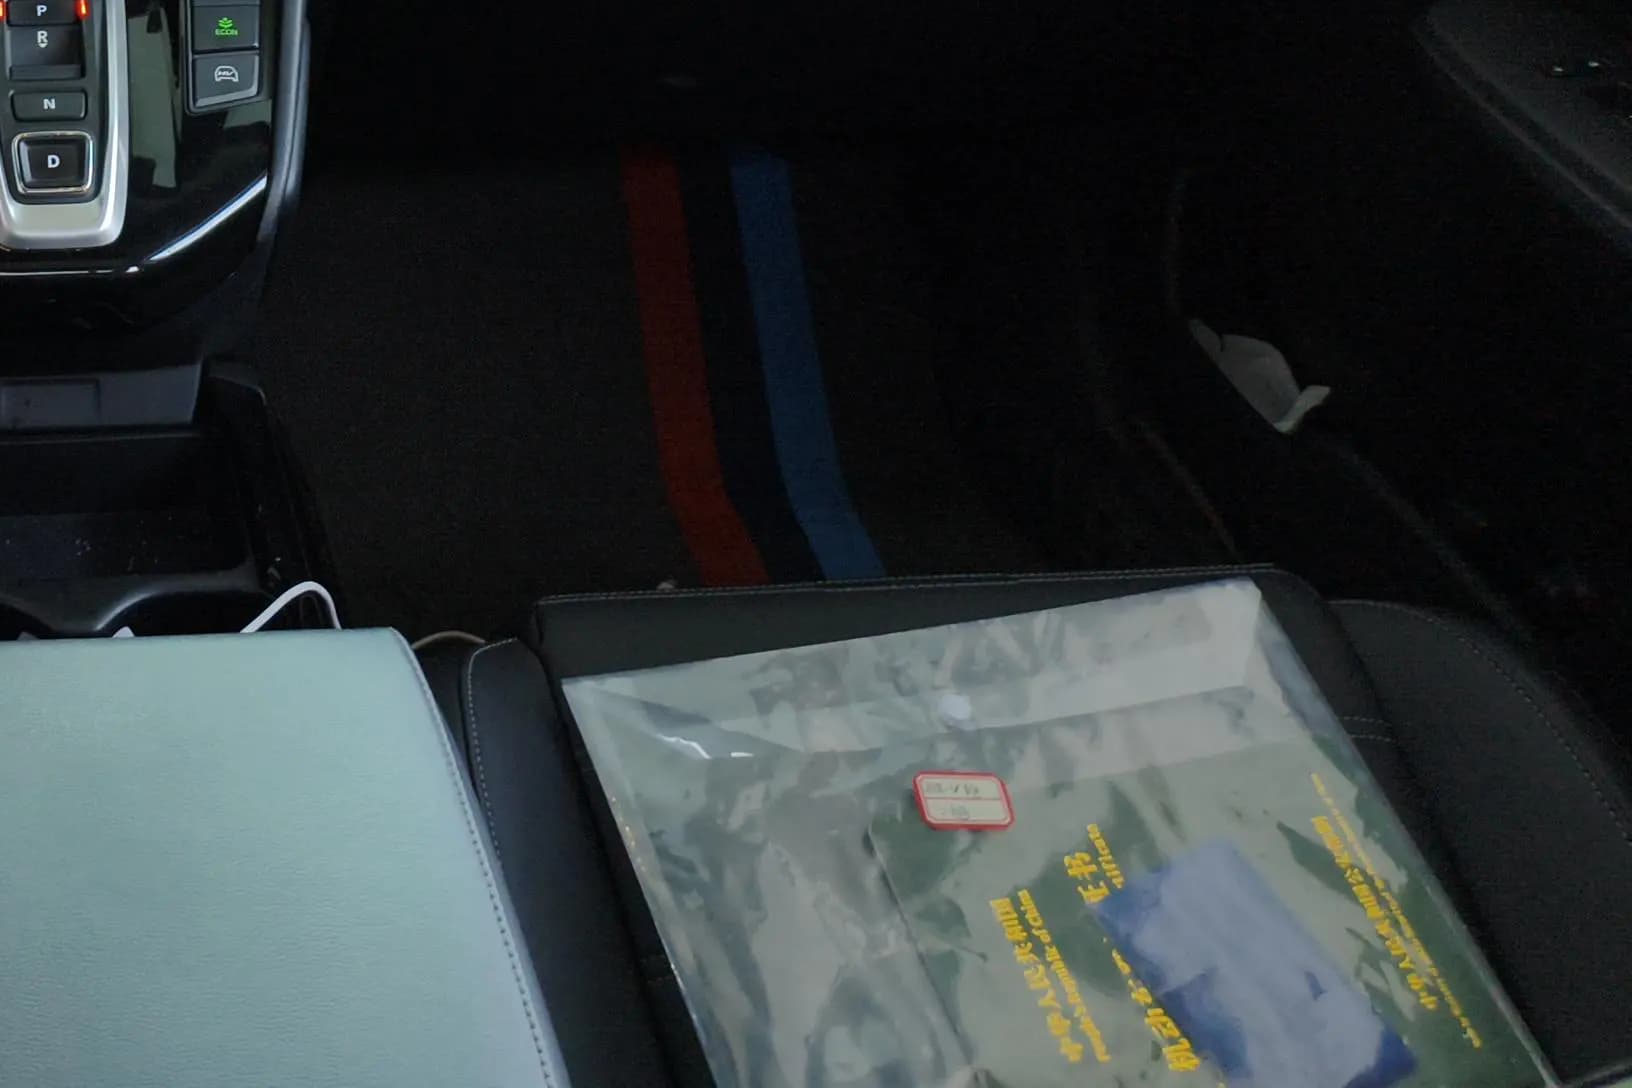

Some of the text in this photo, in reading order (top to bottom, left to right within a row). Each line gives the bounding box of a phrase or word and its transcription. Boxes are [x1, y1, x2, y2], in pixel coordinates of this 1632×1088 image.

[36, 4, 48, 17] P
[36, 30, 48, 43] R
[214, 28, 239, 36] ECON
[43, 98, 56, 110] N
[47, 154, 61, 169] D
[1032, 927, 1052, 945] of
